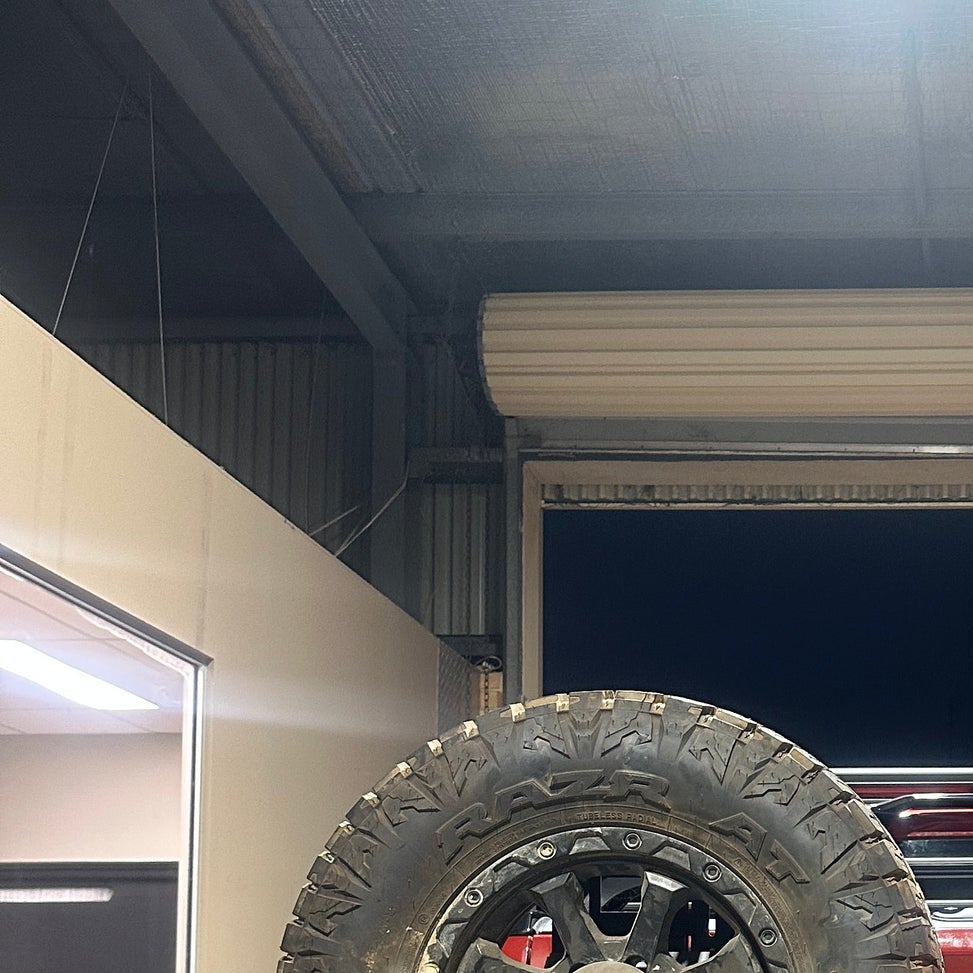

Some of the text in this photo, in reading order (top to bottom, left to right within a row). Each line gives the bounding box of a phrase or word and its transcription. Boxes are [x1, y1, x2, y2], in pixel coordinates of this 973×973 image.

[436, 769, 672, 866] RAZR
[705, 812, 811, 884] AT
[576, 812, 658, 826] TUBELESS RADIAL
